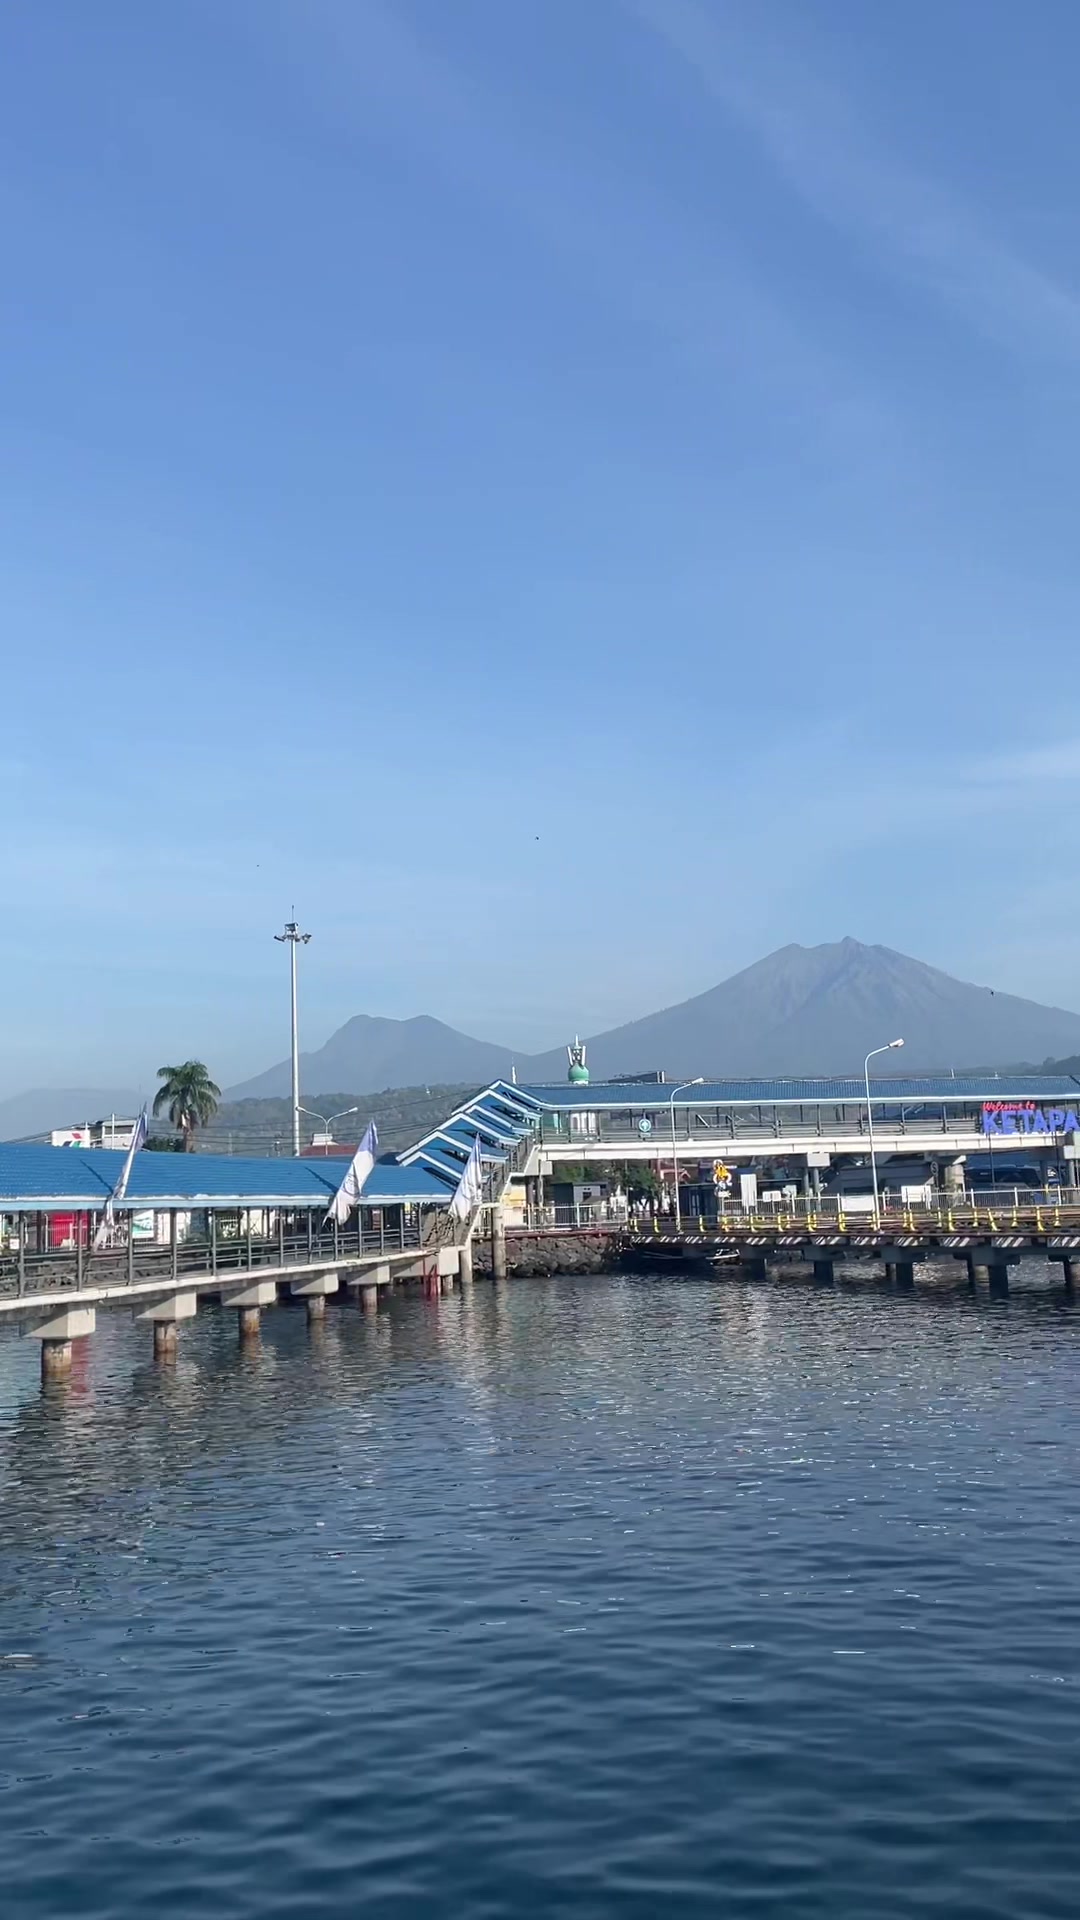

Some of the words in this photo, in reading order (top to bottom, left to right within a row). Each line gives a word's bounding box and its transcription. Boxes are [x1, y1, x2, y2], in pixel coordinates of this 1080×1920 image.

[982, 1101, 1022, 1112] Welcome
[1025, 1100, 1036, 1110] to
[983, 1109, 1080, 1134] KETAPA
